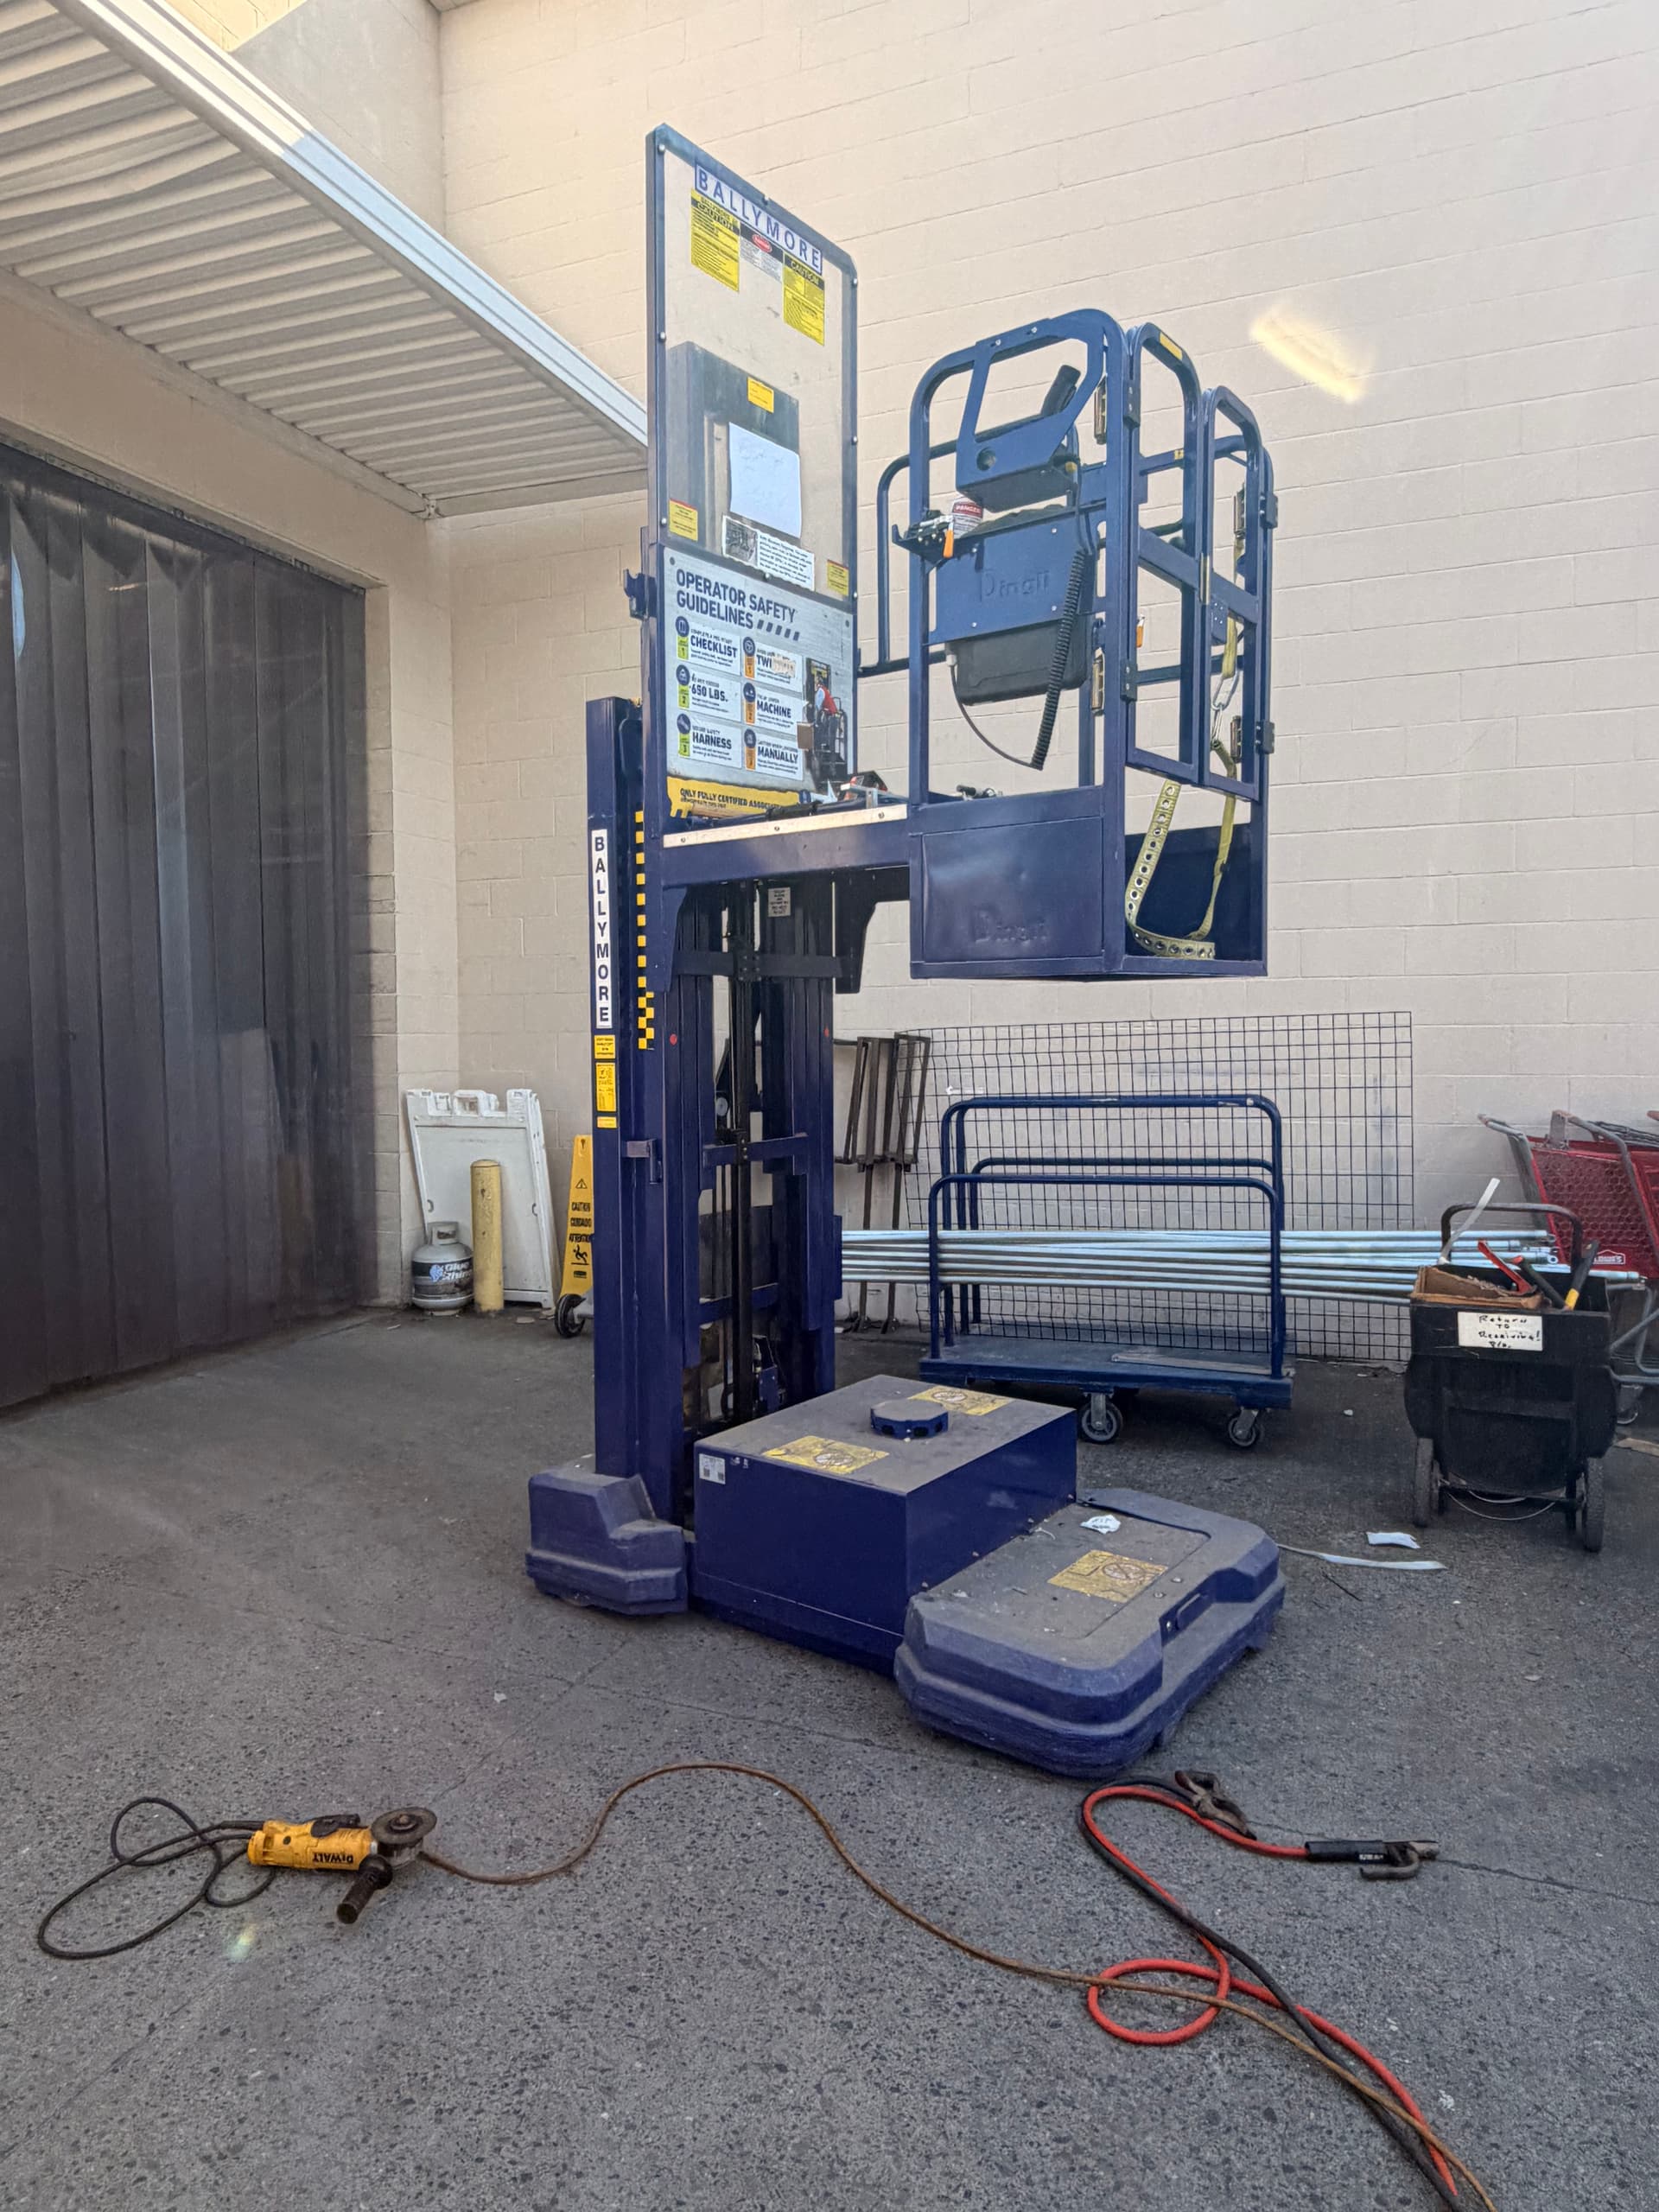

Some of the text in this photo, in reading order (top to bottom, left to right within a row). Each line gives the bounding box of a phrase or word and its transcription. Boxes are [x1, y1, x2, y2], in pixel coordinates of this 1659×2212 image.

[698, 169, 820, 269] BALLYMORE
[676, 569, 796, 623] OPERATOR SAFETY
[676, 589, 753, 629] GUIDELINES
[690, 634, 738, 658] CHECKLIST
[691, 683, 728, 702] 650 LBS.
[757, 699, 791, 719] MACHINE
[692, 731, 732, 750] HARNESS
[758, 746, 798, 764] MANUALLY
[680, 787, 696, 798] ONLY
[697, 791, 717, 801] FULLY
[718, 794, 747, 806] CERTIFIED
[594, 836, 609, 1021] BALLYMORE
